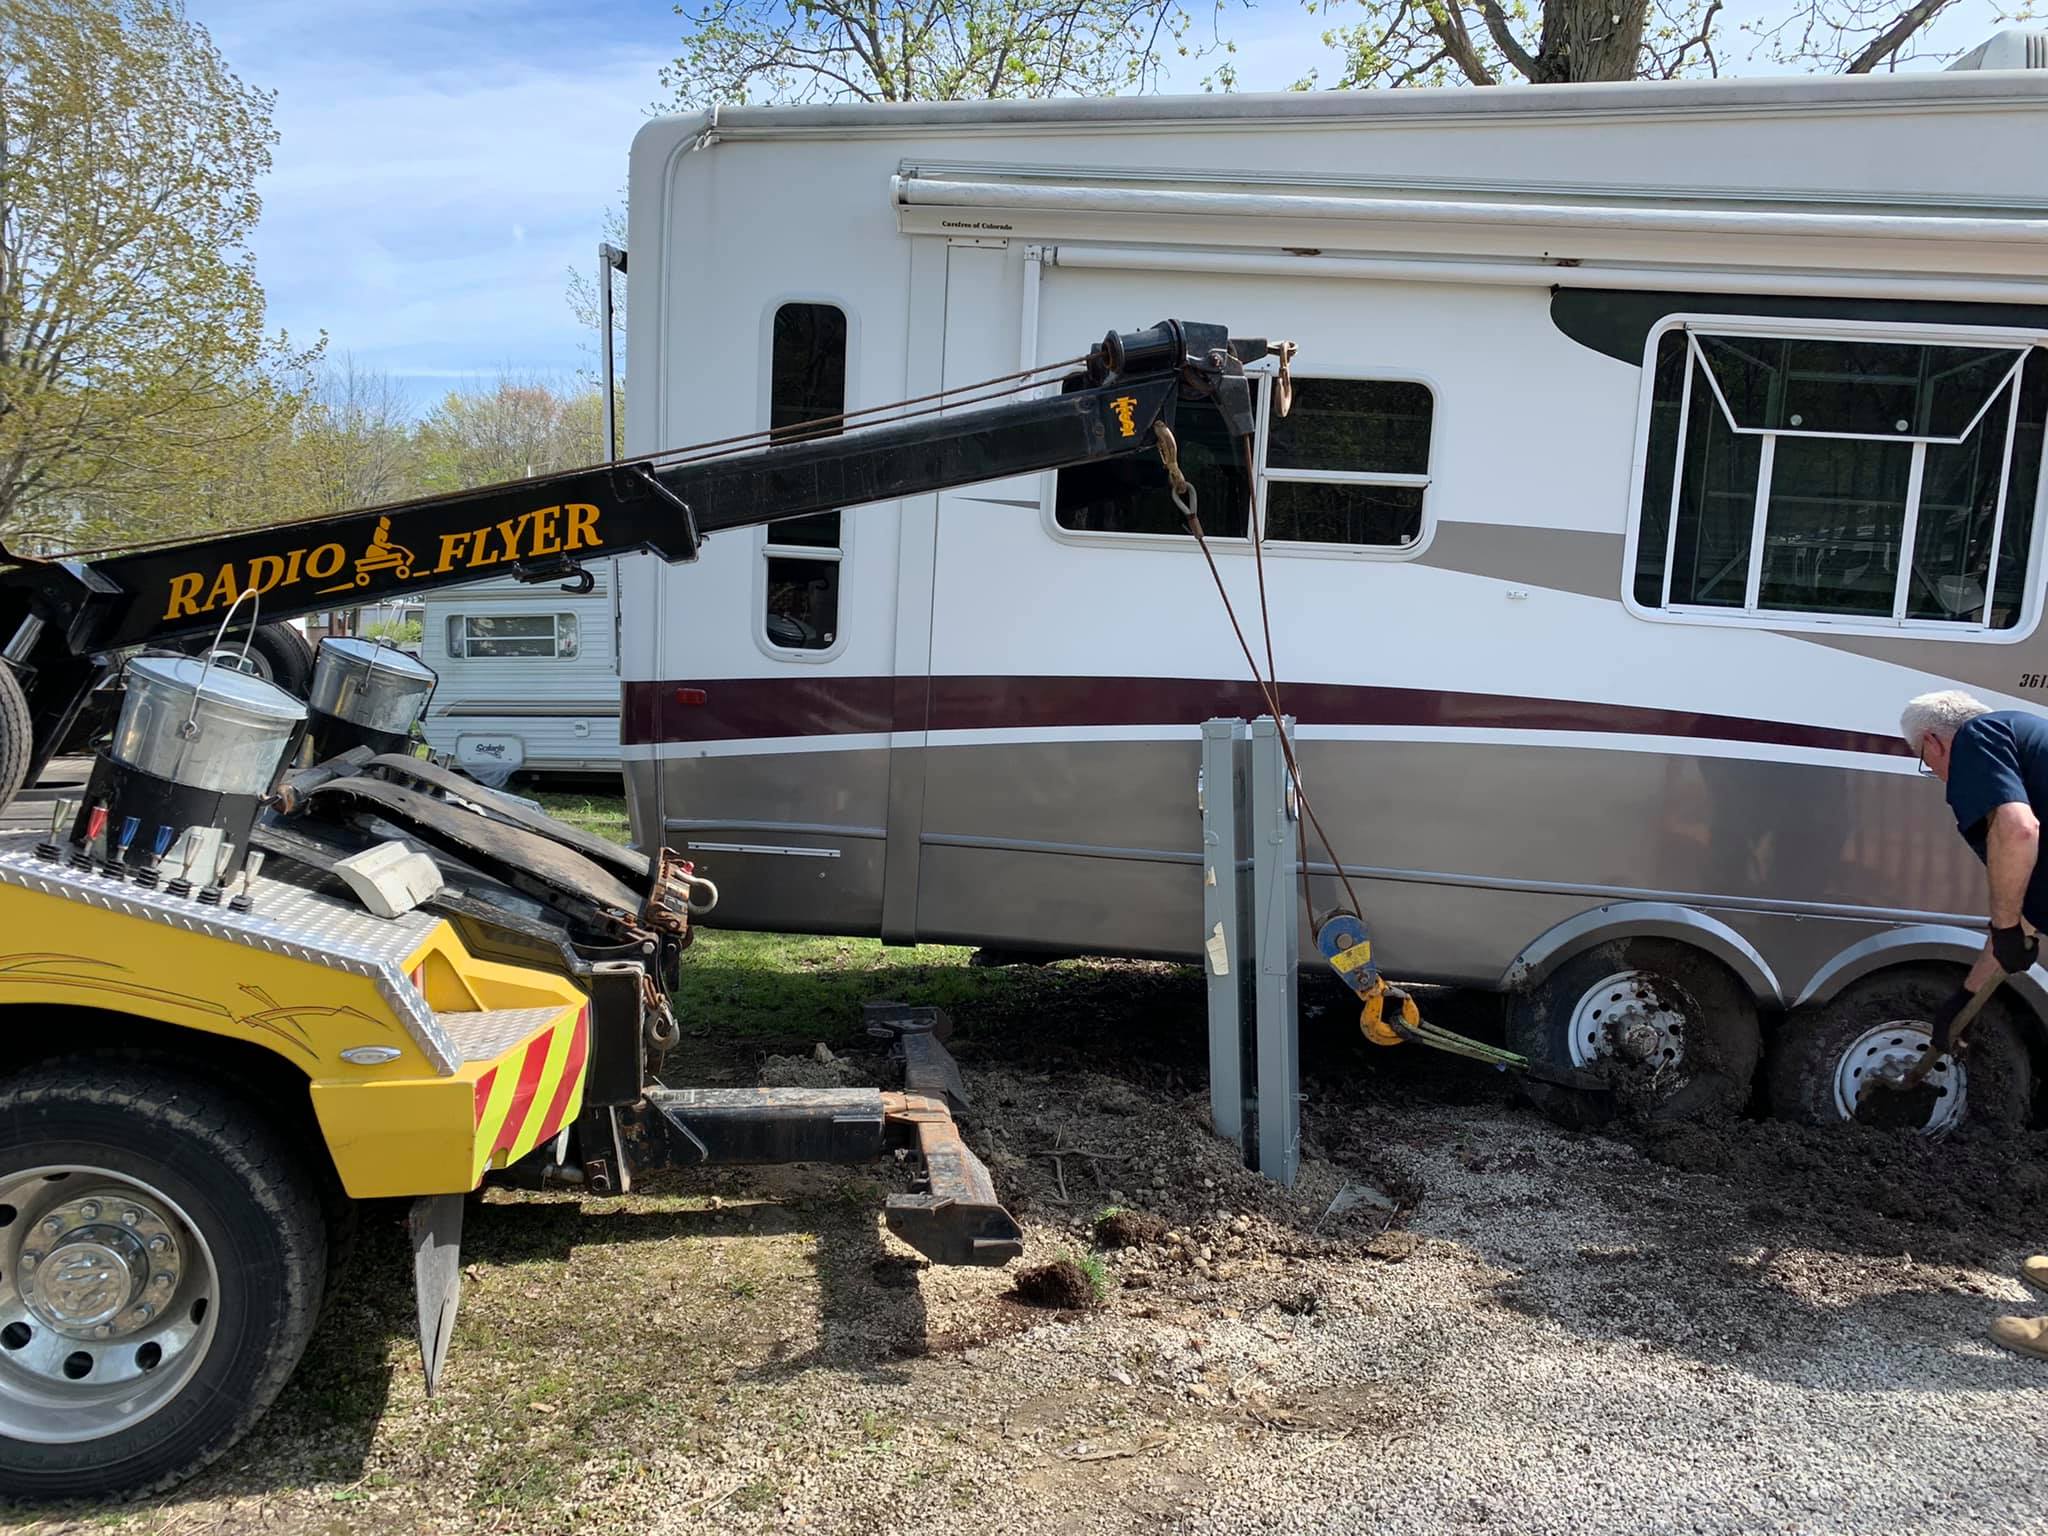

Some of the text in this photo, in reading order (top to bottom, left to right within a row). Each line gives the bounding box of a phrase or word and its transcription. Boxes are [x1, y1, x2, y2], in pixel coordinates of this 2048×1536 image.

[163, 503, 603, 621] RADIO FLYER
[2019, 673, 2048, 688] 361
